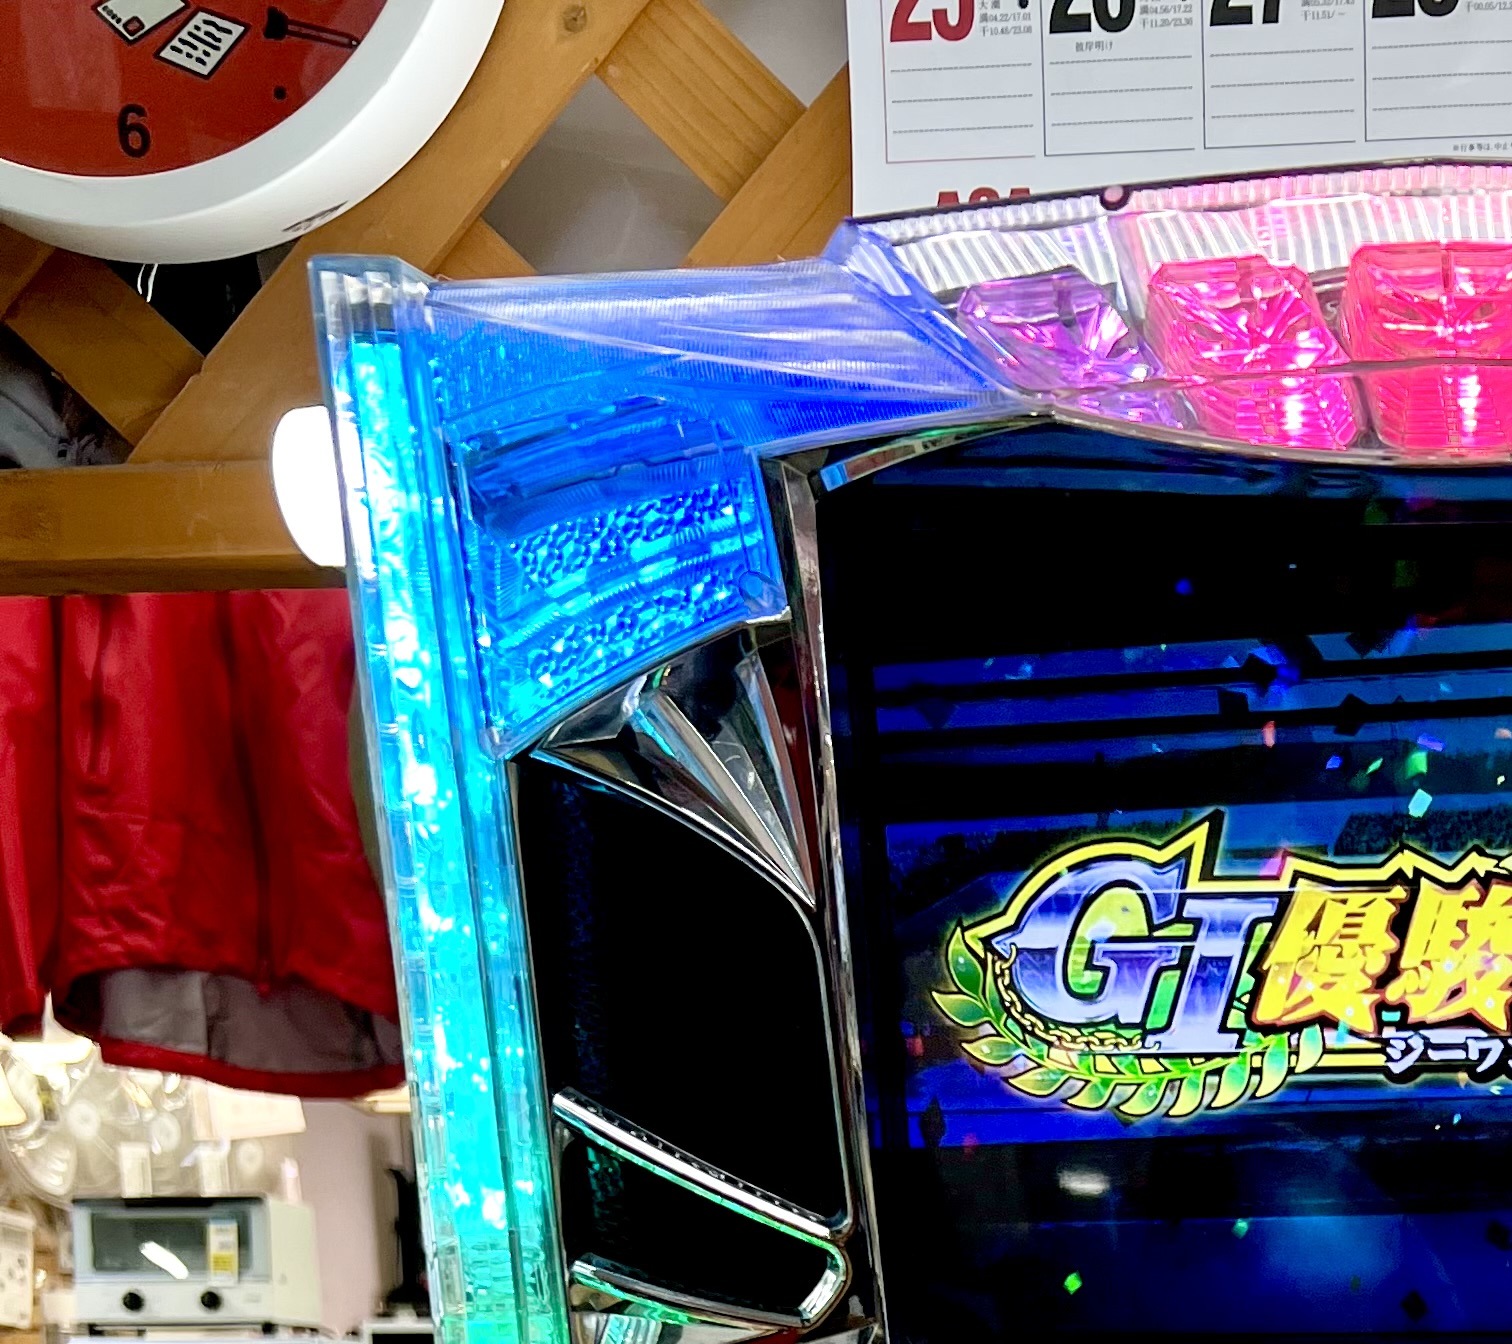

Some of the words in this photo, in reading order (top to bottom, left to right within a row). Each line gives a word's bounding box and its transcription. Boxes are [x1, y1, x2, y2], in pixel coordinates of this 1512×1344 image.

[1075, 40, 1113, 52] 彼岸明け
[117, 103, 152, 158] 6
